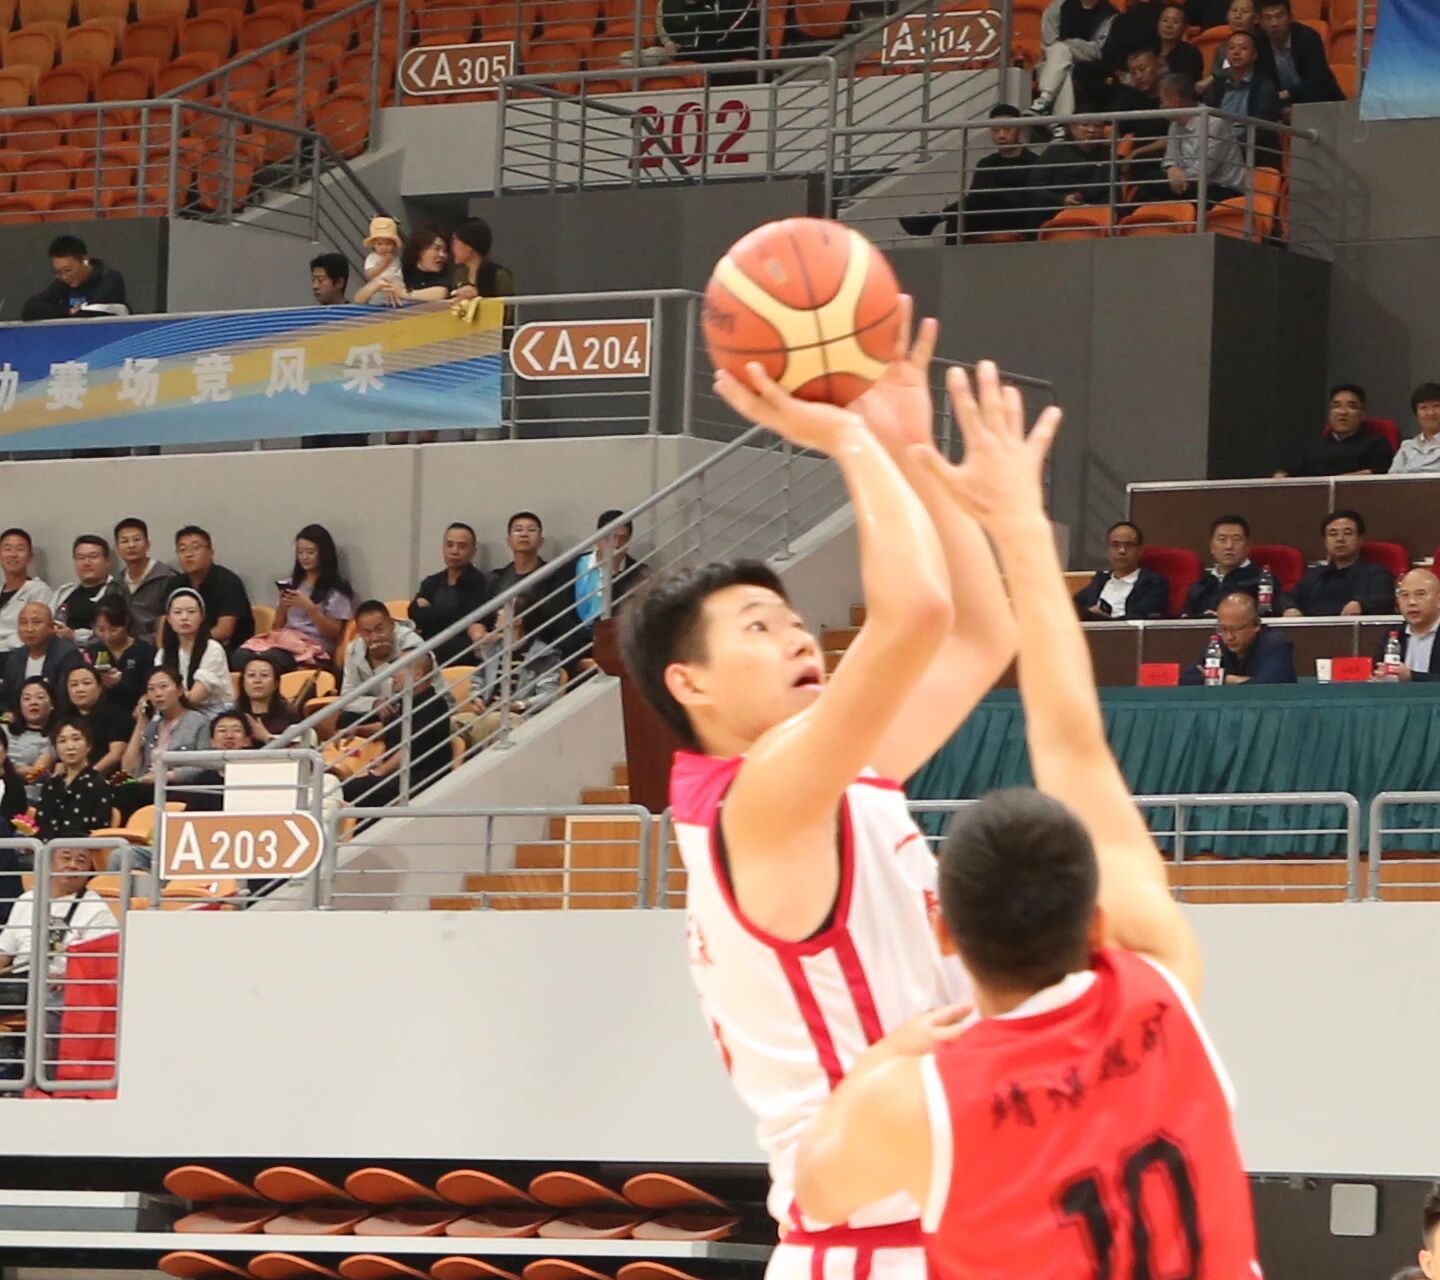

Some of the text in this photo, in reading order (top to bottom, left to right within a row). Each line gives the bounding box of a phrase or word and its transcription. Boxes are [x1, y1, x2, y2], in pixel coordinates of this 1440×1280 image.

[428, 50, 512, 87] A305
[627, 100, 751, 169] 202
[547, 328, 643, 371] A204
[168, 819, 283, 870] A203
